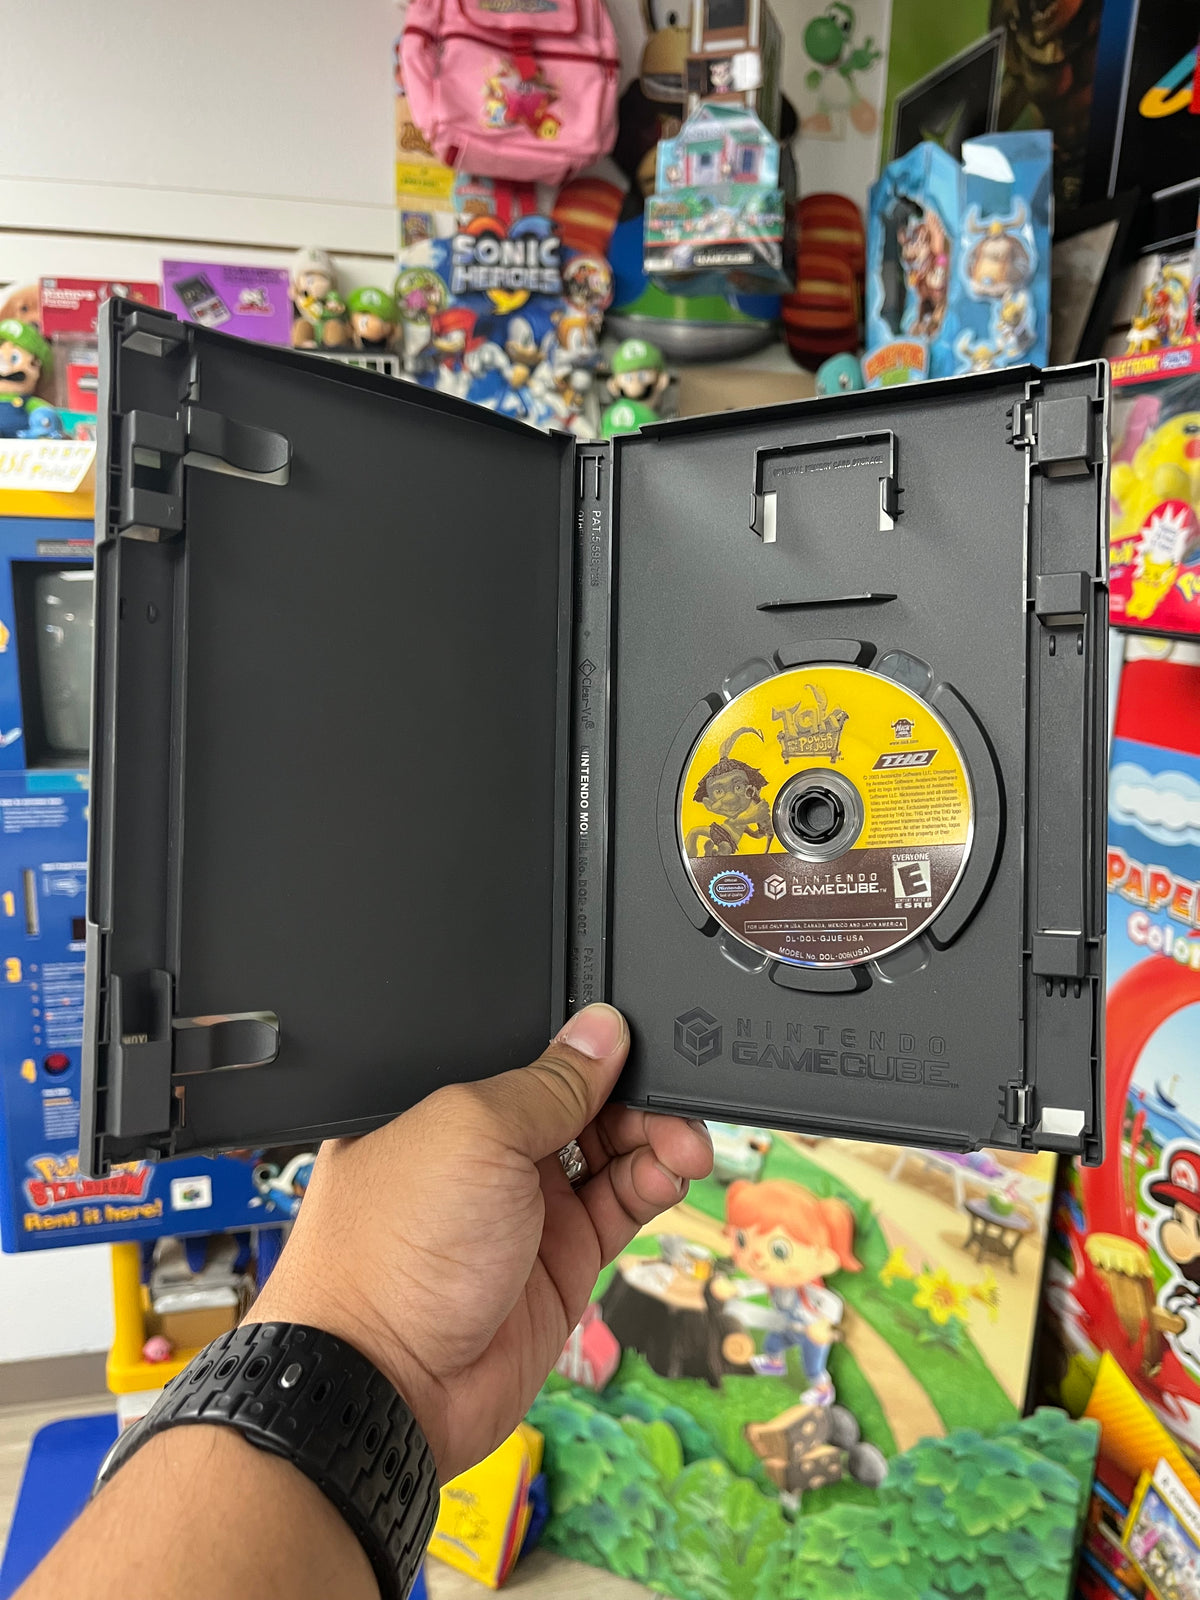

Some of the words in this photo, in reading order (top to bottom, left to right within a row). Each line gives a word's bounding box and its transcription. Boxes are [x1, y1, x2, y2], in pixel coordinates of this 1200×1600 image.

[452, 234, 560, 267] SONIC
[451, 265, 562, 295] HEROES
[881, 752, 929, 767] THQ
[892, 853, 930, 861] EVERYONE
[792, 883, 879, 895] GAMECUBE
[793, 873, 877, 884] NINTENDO
[897, 863, 928, 896] E
[1107, 850, 1200, 925] PAPE
[779, 946, 804, 959] MODEL
[736, 1017, 946, 1056] NINTENDO
[732, 1040, 950, 1088] GAMECUBE
[27, 1167, 150, 1207] STADIUM
[24, 1211, 77, 1231] Rent
[83, 1207, 100, 1224] it
[105, 1199, 162, 1221] here!
